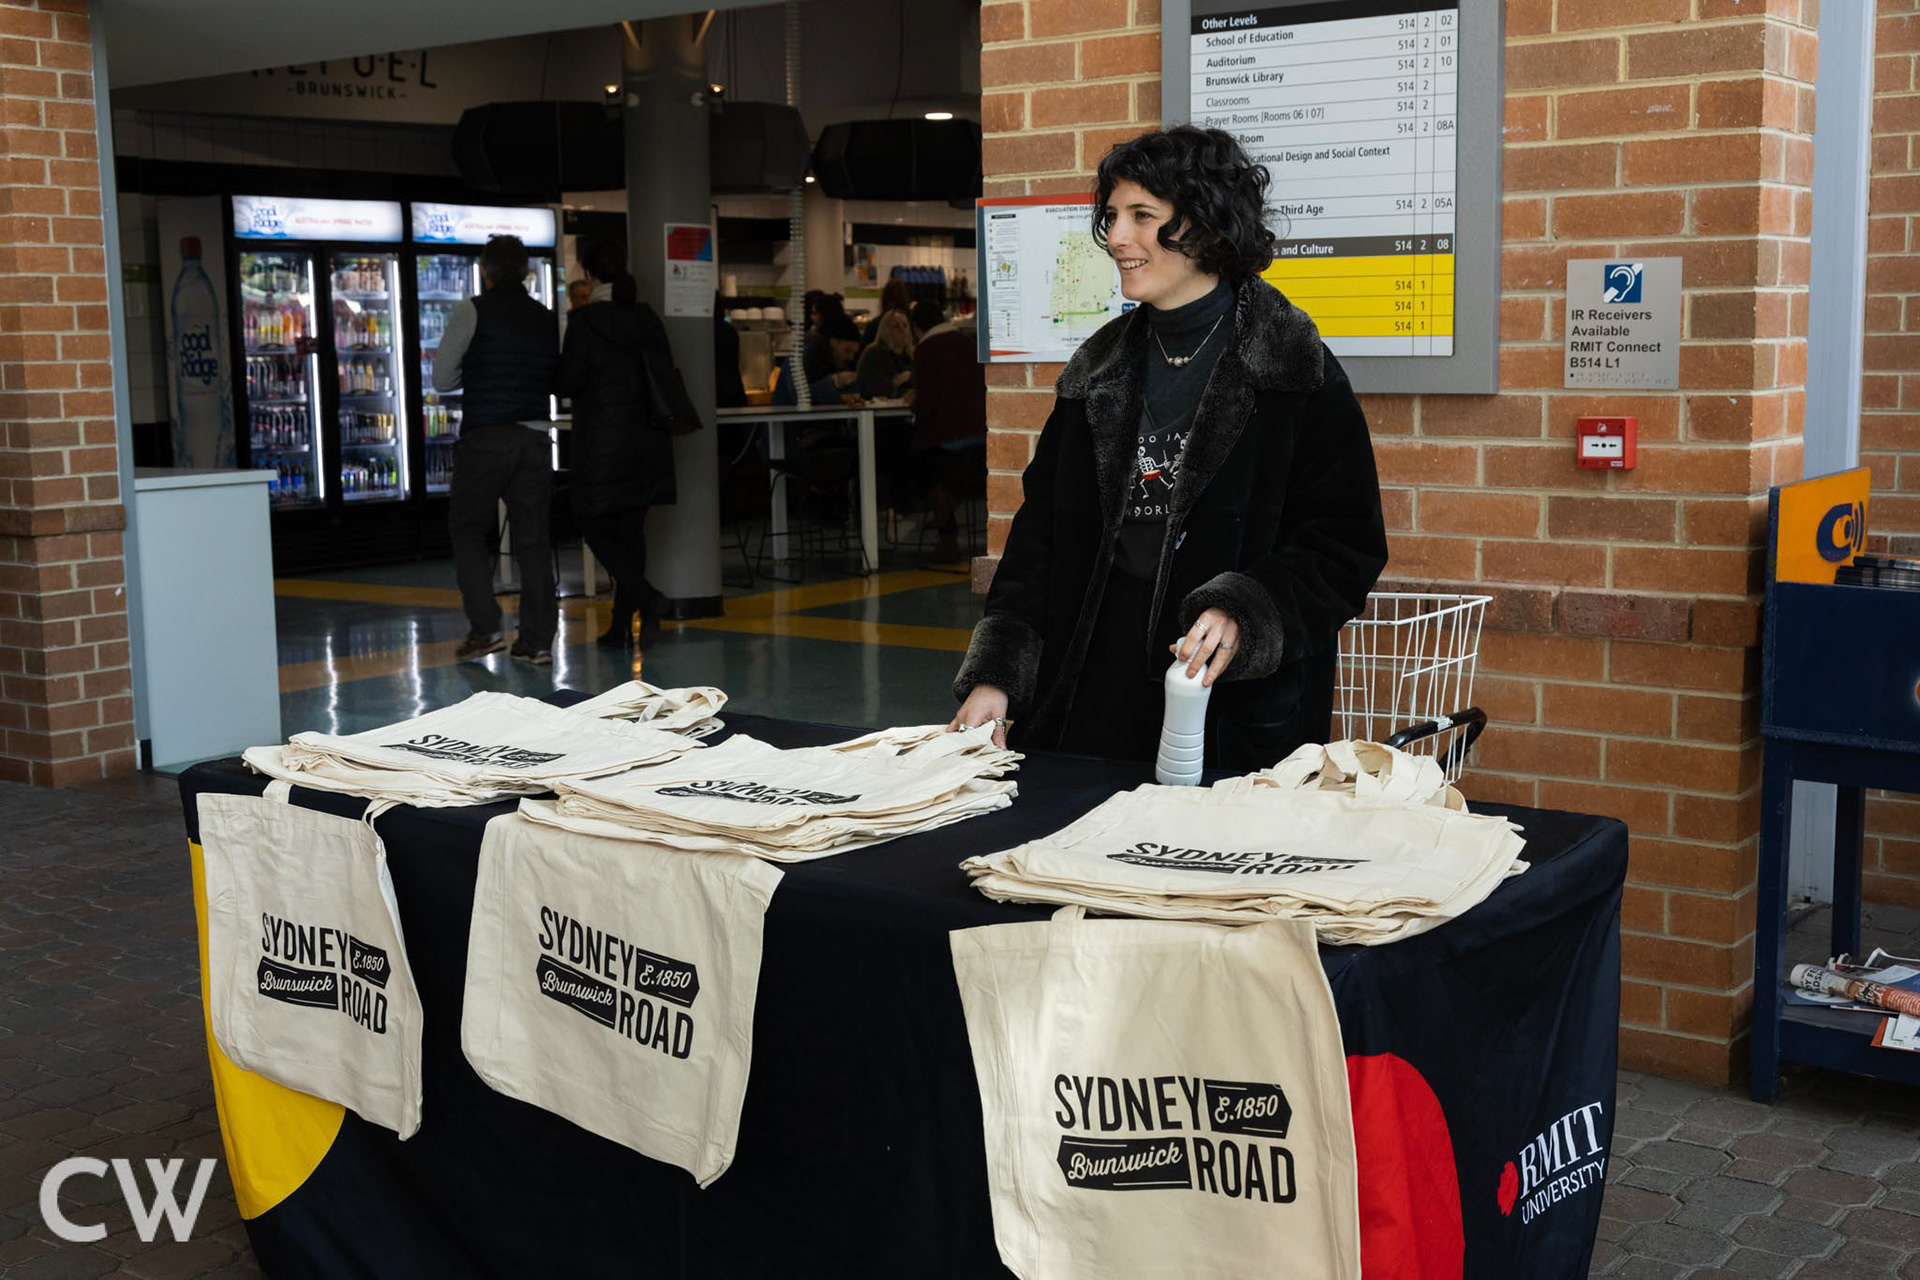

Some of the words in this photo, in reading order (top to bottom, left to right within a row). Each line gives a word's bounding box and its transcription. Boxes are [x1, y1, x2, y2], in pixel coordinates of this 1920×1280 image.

[1202, 18, 1227, 30] Other
[1229, 14, 1257, 27] Levels
[1206, 36, 1235, 47] School
[1238, 34, 1247, 44] of
[1250, 30, 1294, 43] Education
[1398, 18, 1415, 30] 514
[1424, 17, 1430, 28] 2
[1441, 15, 1452, 26] 02
[1206, 55, 1256, 68] Auditorium
[1398, 38, 1415, 50] 514
[1424, 37, 1430, 48] 2
[1441, 36, 1452, 47] 01
[1206, 73, 1250, 87] Brunswick
[1253, 70, 1284, 84] Library
[1398, 59, 1415, 71] 514
[1423, 58, 1429, 68] 2
[1441, 56, 1452, 67] 10
[1206, 96, 1250, 107] Classrooms
[1397, 81, 1414, 92] 514
[1423, 80, 1429, 91] 2
[1206, 116, 1230, 128] Prayer
[1232, 114, 1258, 123] Rooms
[1261, 111, 1291, 124] [Rooms
[1293, 109, 1303, 119] 06
[1311, 107, 1324, 119] 07]
[1397, 100, 1414, 112] 514
[1422, 100, 1428, 110] 2
[1240, 134, 1264, 144] Room
[1397, 122, 1414, 134] 514
[1423, 122, 1428, 132] 2
[1436, 120, 1454, 131] 08A
[1286, 151, 1312, 163] Design
[1315, 149, 1329, 160] and
[1332, 146, 1356, 159] Social
[1358, 146, 1390, 157] Context
[1281, 205, 1303, 214] Third
[1306, 204, 1324, 216] Age
[1396, 199, 1413, 210] 514
[1421, 199, 1427, 209] 2
[1435, 197, 1452, 208] 05A
[1281, 244, 1298, 255] and
[1300, 244, 1334, 255] Culture
[1395, 240, 1412, 251] 514
[1420, 240, 1426, 250] 2
[1437, 239, 1449, 250] 08
[1396, 280, 1412, 291] 514
[1421, 280, 1425, 290] 1
[1396, 301, 1412, 311] 514
[1421, 301, 1425, 311] 1
[1571, 310, 1584, 320] IR
[1589, 309, 1652, 320] Receivers
[1395, 321, 1411, 331] 514
[1421, 321, 1425, 331] 1
[1572, 325, 1630, 336] Available
[1570, 341, 1603, 352] RMIT
[1607, 341, 1661, 353] Connect
[1570, 357, 1601, 368] B514
[1606, 357, 1620, 368] L1
[1126, 842, 1293, 863] SYDNEY
[262, 912, 348, 970] SYDNEY
[352, 950, 385, 972] E.1850
[538, 905, 634, 986] SYDNEY
[638, 964, 692, 989] E.1850
[260, 970, 334, 992] Brunswick
[542, 970, 614, 1006] Brunswick
[341, 974, 388, 1035] ROAD
[618, 990, 694, 1060] ROAD
[1054, 1073, 1201, 1132] SYDNEY
[1214, 1094, 1279, 1124] E.1850
[1068, 1142, 1183, 1180] Brunswick
[1518, 1101, 1603, 1200] RMIT
[1192, 1137, 1297, 1204] ROAD
[1522, 1158, 1605, 1224] UNIVERSITY
